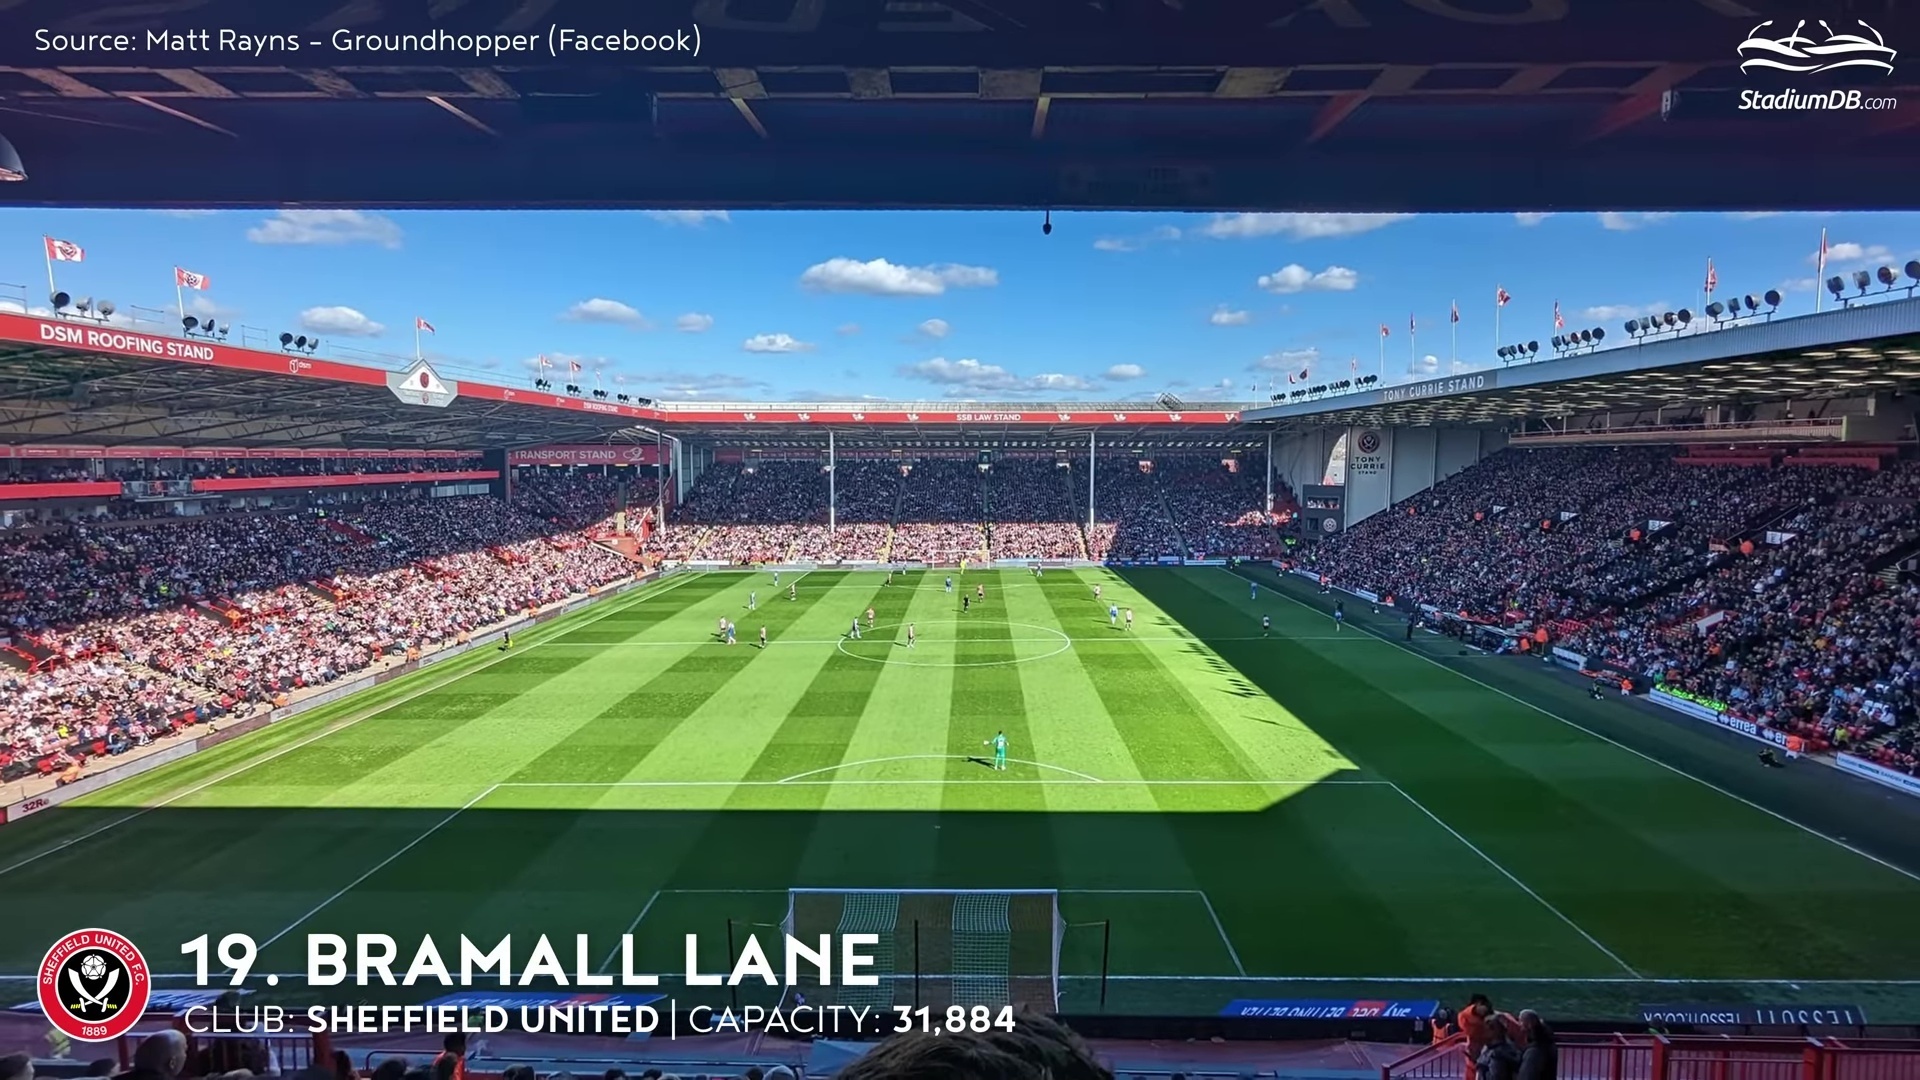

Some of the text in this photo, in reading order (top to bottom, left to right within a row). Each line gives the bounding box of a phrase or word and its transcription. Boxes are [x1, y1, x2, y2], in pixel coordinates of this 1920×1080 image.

[40, 323, 214, 361] DSM ROOFING STAND
[1383, 375, 1484, 401] TONY CURRIE STAND
[974, 413, 992, 421] LAW
[994, 413, 1021, 421] STAND
[515, 450, 577, 460] TRANSPORT
[580, 450, 617, 460] STAND
